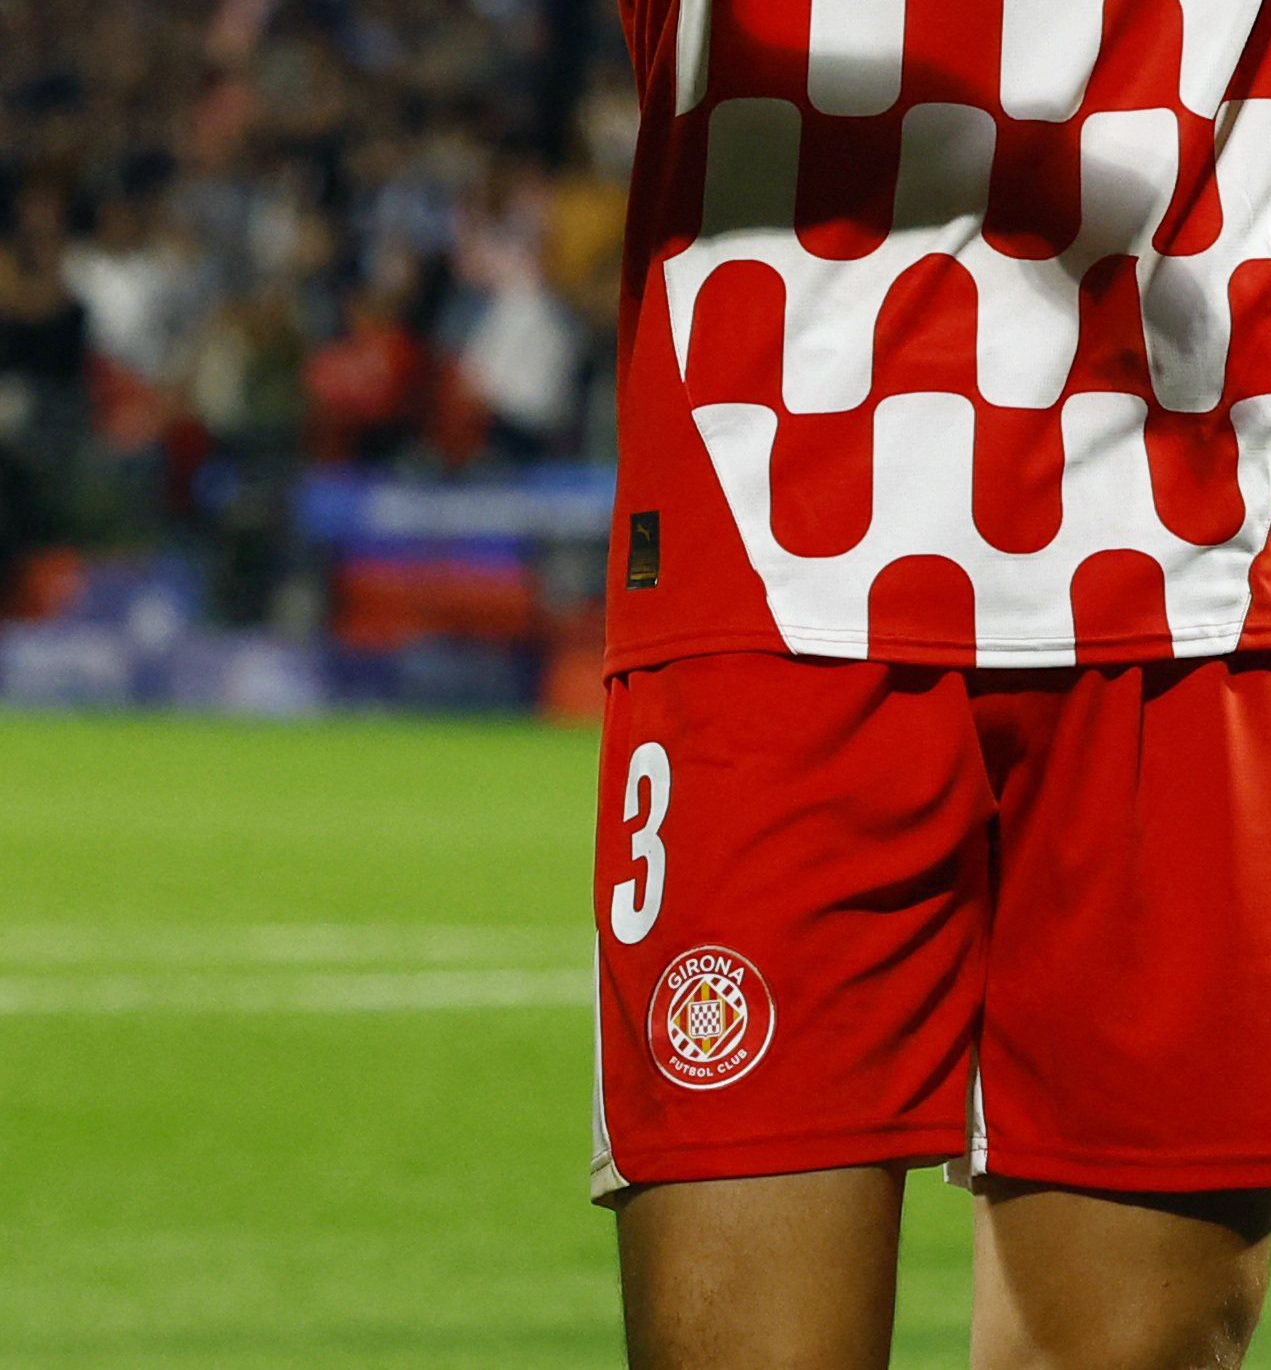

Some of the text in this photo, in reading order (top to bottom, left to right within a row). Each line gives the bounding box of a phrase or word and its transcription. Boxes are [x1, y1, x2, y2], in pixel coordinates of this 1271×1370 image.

[611, 741, 672, 945] 3
[667, 955, 745, 989] GIRONA
[668, 1048, 748, 1077] FUTBOL CLUB
